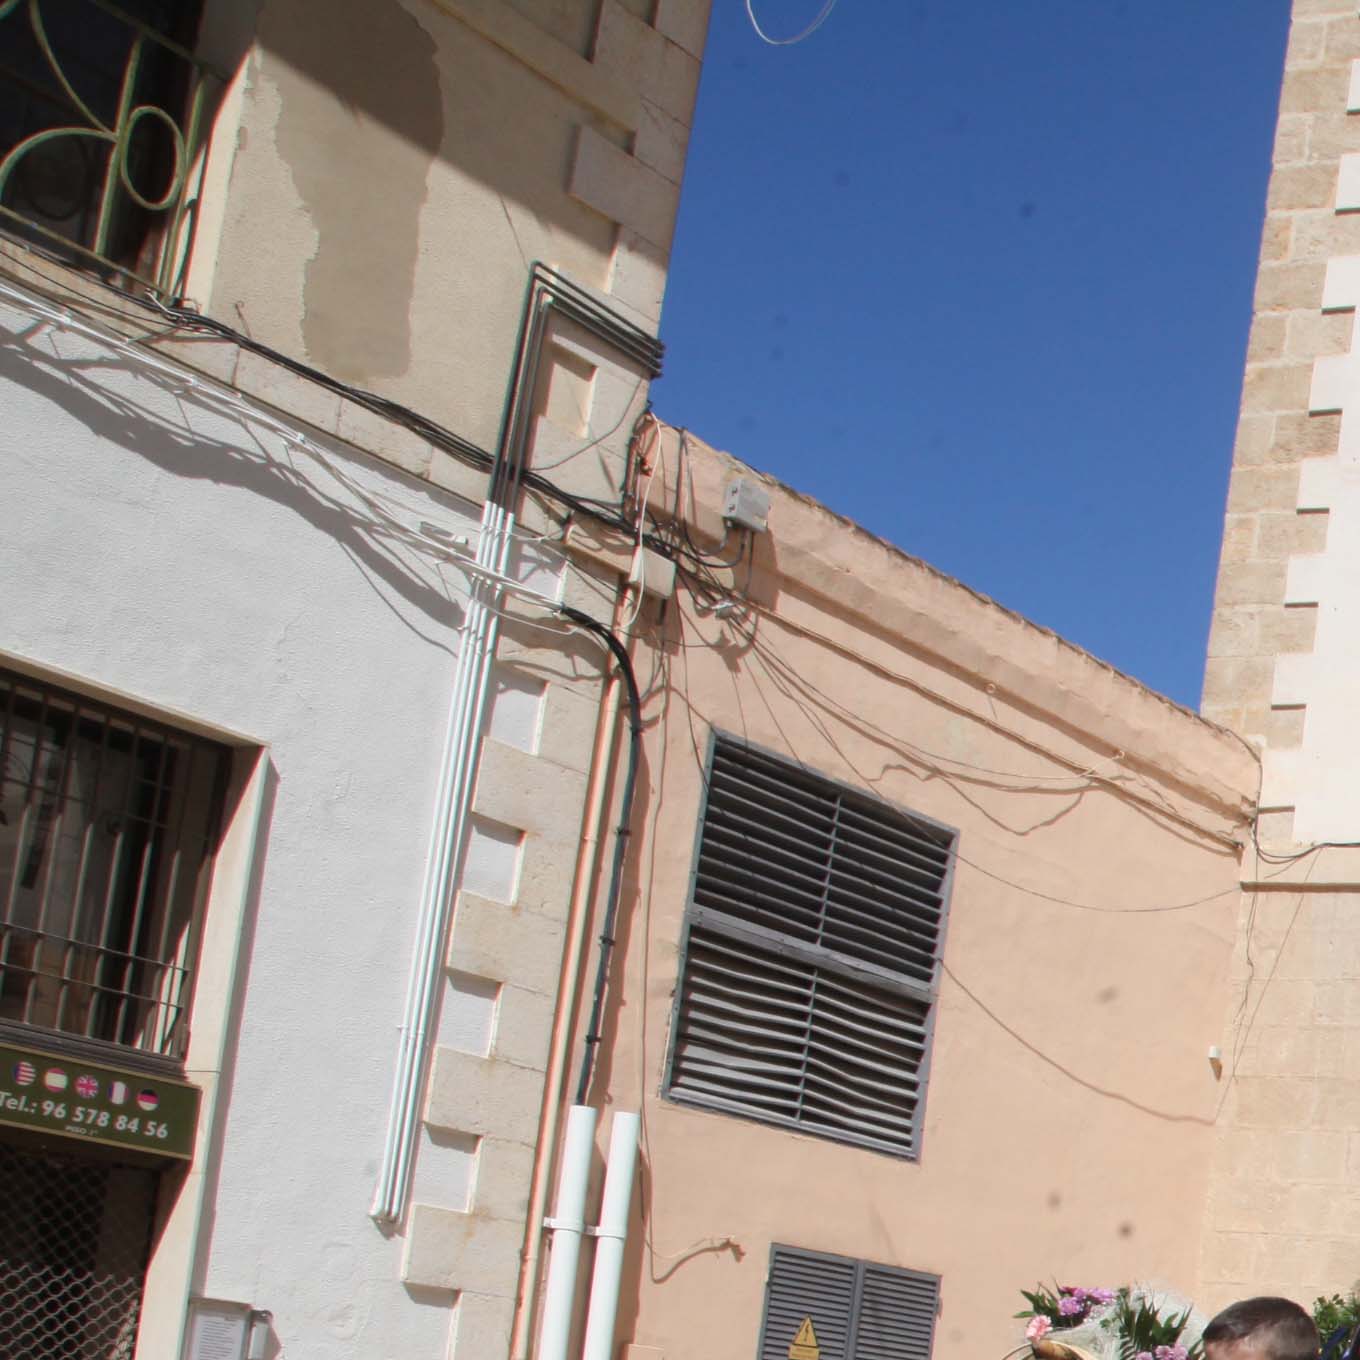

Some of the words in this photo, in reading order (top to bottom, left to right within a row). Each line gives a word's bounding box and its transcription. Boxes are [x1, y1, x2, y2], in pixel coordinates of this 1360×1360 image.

[42, 1101, 66, 1118] 96
[72, 1107, 110, 1127] 578
[115, 1115, 139, 1133] 84
[145, 1121, 168, 1139] 56
